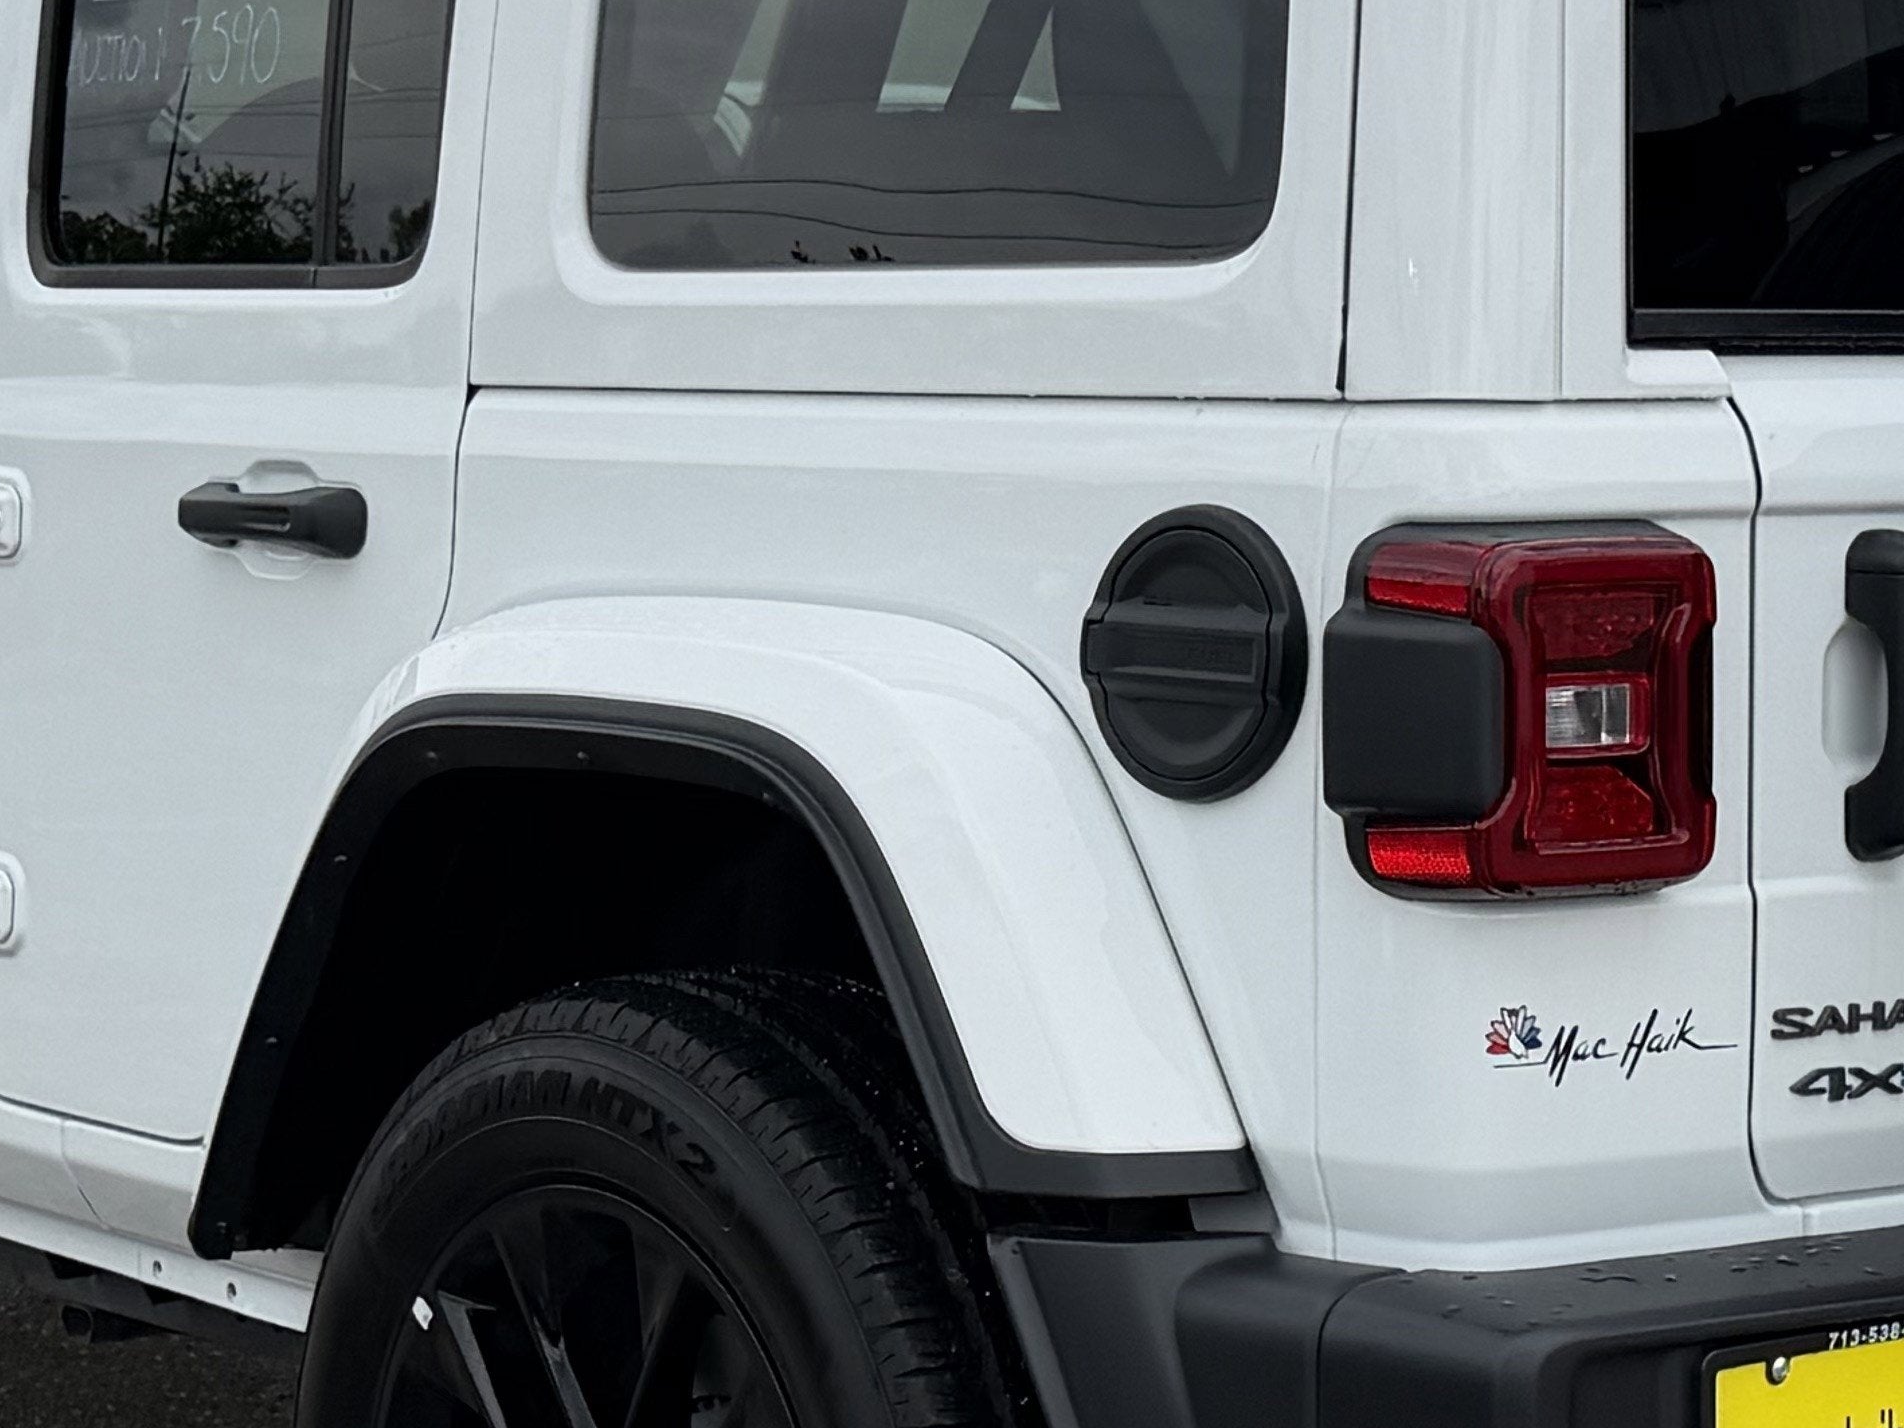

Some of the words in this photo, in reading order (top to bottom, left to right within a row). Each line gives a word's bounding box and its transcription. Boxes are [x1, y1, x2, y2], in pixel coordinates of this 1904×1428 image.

[181, 3, 281, 85] 7590
[1542, 1021, 1619, 1087] Mac
[1622, 1007, 1708, 1080] Haik
